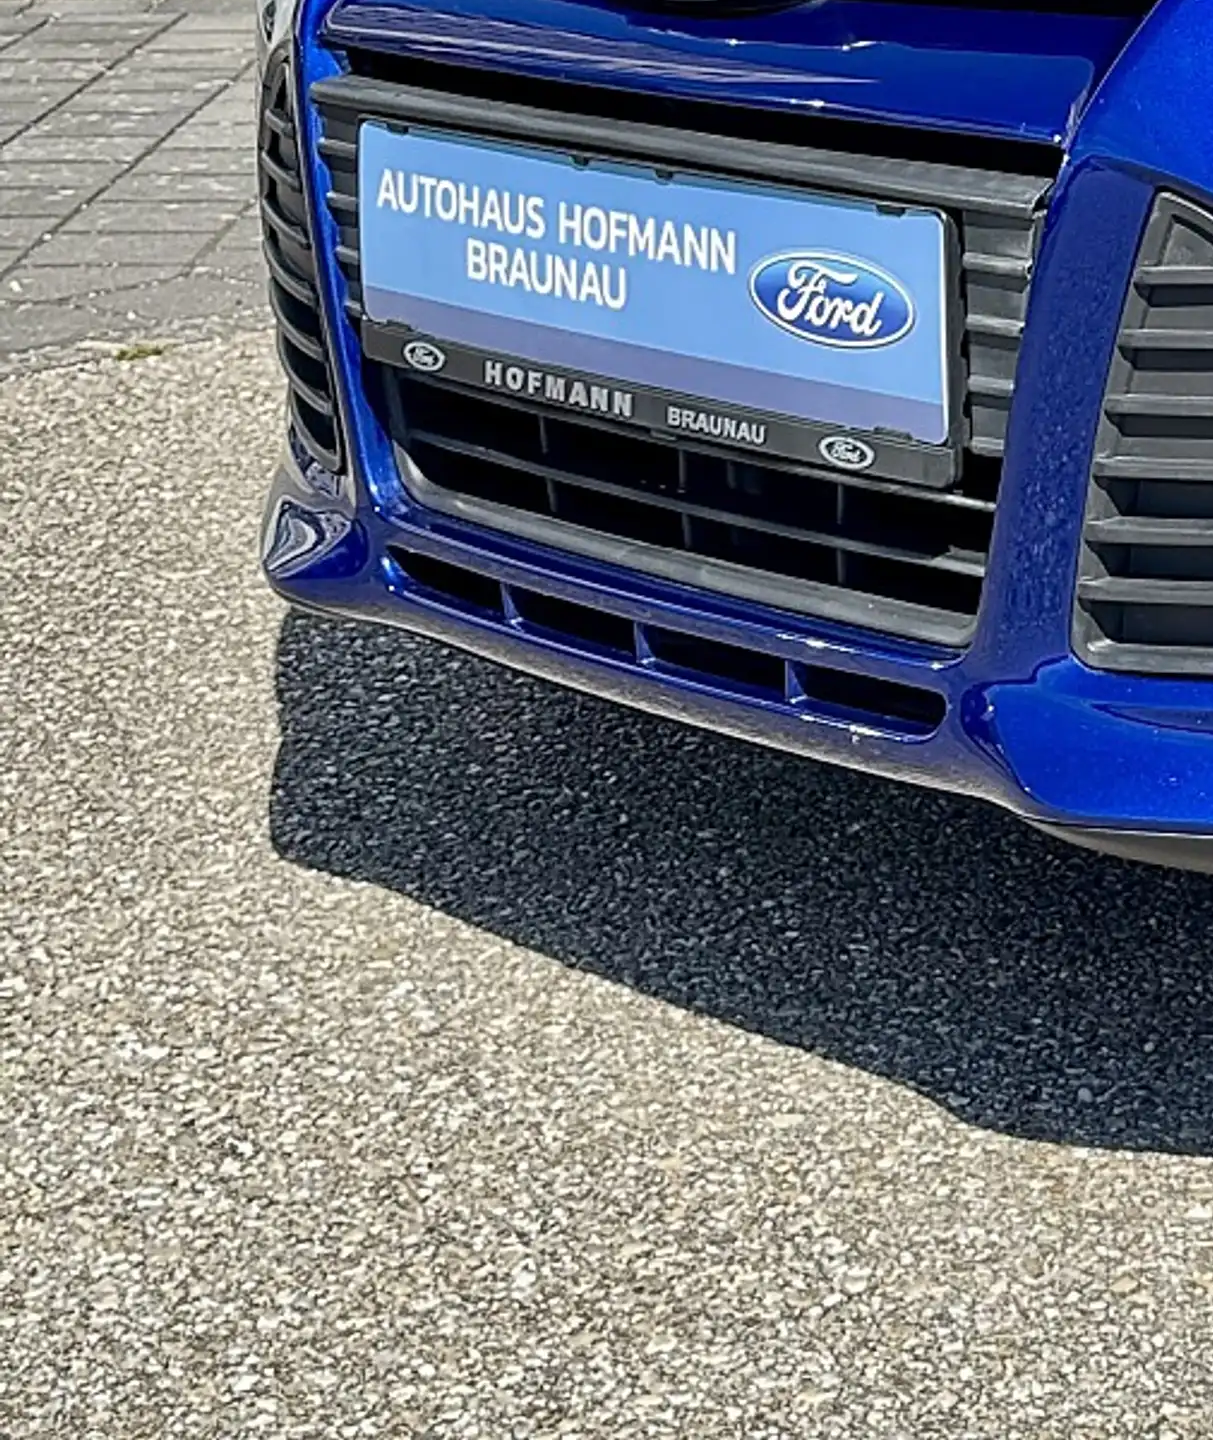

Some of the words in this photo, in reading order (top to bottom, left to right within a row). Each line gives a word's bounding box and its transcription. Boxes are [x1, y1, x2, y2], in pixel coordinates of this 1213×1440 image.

[377, 169, 546, 239] AUTOHAUS
[558, 201, 736, 275] HOFMANN
[466, 238, 627, 310] BRAUNAU
[777, 260, 885, 337] Ford
[484, 360, 633, 417] HOFMANN
[667, 406, 766, 444] BRAUNAU
